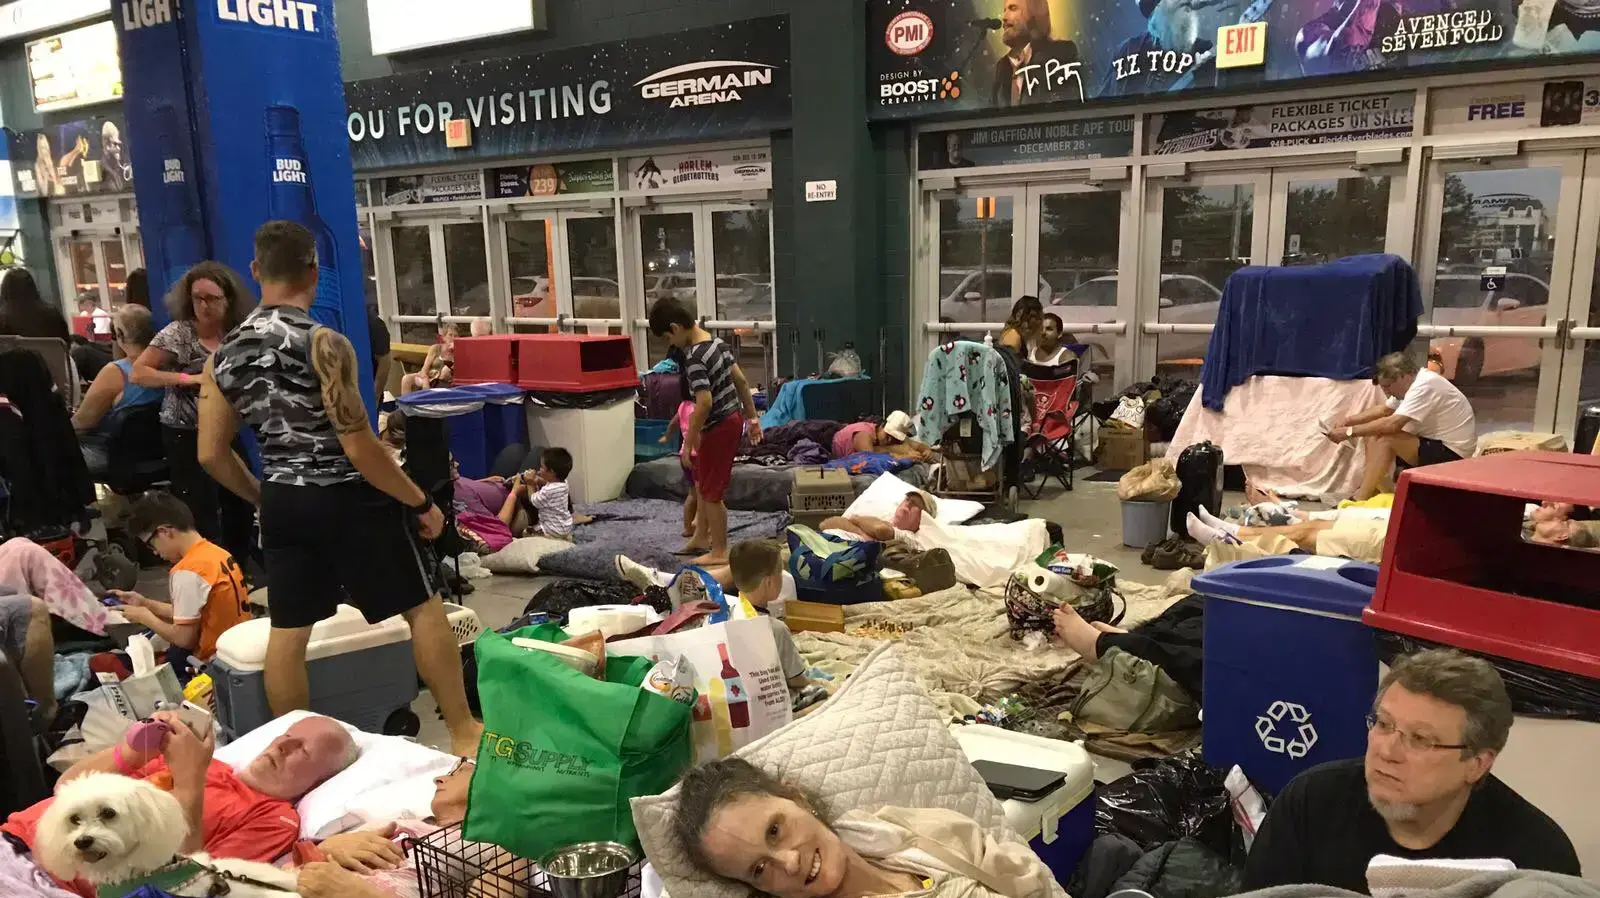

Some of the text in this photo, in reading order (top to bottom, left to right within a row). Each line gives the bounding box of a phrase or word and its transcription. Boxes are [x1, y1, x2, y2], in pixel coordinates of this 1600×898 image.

[121, 0, 184, 30] LIGH
[217, 0, 317, 32] LIGHT
[1394, 9, 1492, 36] AVENGED
[894, 24, 923, 44] PMI
[1225, 26, 1258, 55] EXIT
[1381, 24, 1503, 53] SEVENFOLD
[1112, 50, 1193, 80] ZZ TOP
[641, 68, 772, 99] GERMAIN
[880, 69, 923, 80] DESIGN BY
[880, 79, 939, 97] BOOST
[669, 90, 742, 109] ARENA
[880, 94, 937, 106] CREATIVE
[1271, 97, 1390, 119] FLEXIBLE TICKET
[347, 80, 612, 142] OU FOR VISITING
[1467, 102, 1526, 121] FREE
[970, 131, 988, 145] JIM
[990, 127, 1042, 143] GAFFIGAN
[1045, 123, 1080, 139] NOBLE
[1083, 121, 1104, 135] APE
[1270, 117, 1345, 134] PACKAGES
[1019, 140, 1086, 154] DECEMBER 28
[164, 158, 181, 170] BUD
[276, 158, 302, 170] BUD
[679, 159, 712, 173] HARLEM
[163, 170, 185, 184] LIGHT
[272, 170, 307, 183] LIGHT
[533, 178, 555, 193] 239
[673, 171, 720, 184] GLOBETROTTERS
[807, 191, 834, 199] RE-ENTRY
[816, 183, 826, 191] NO
